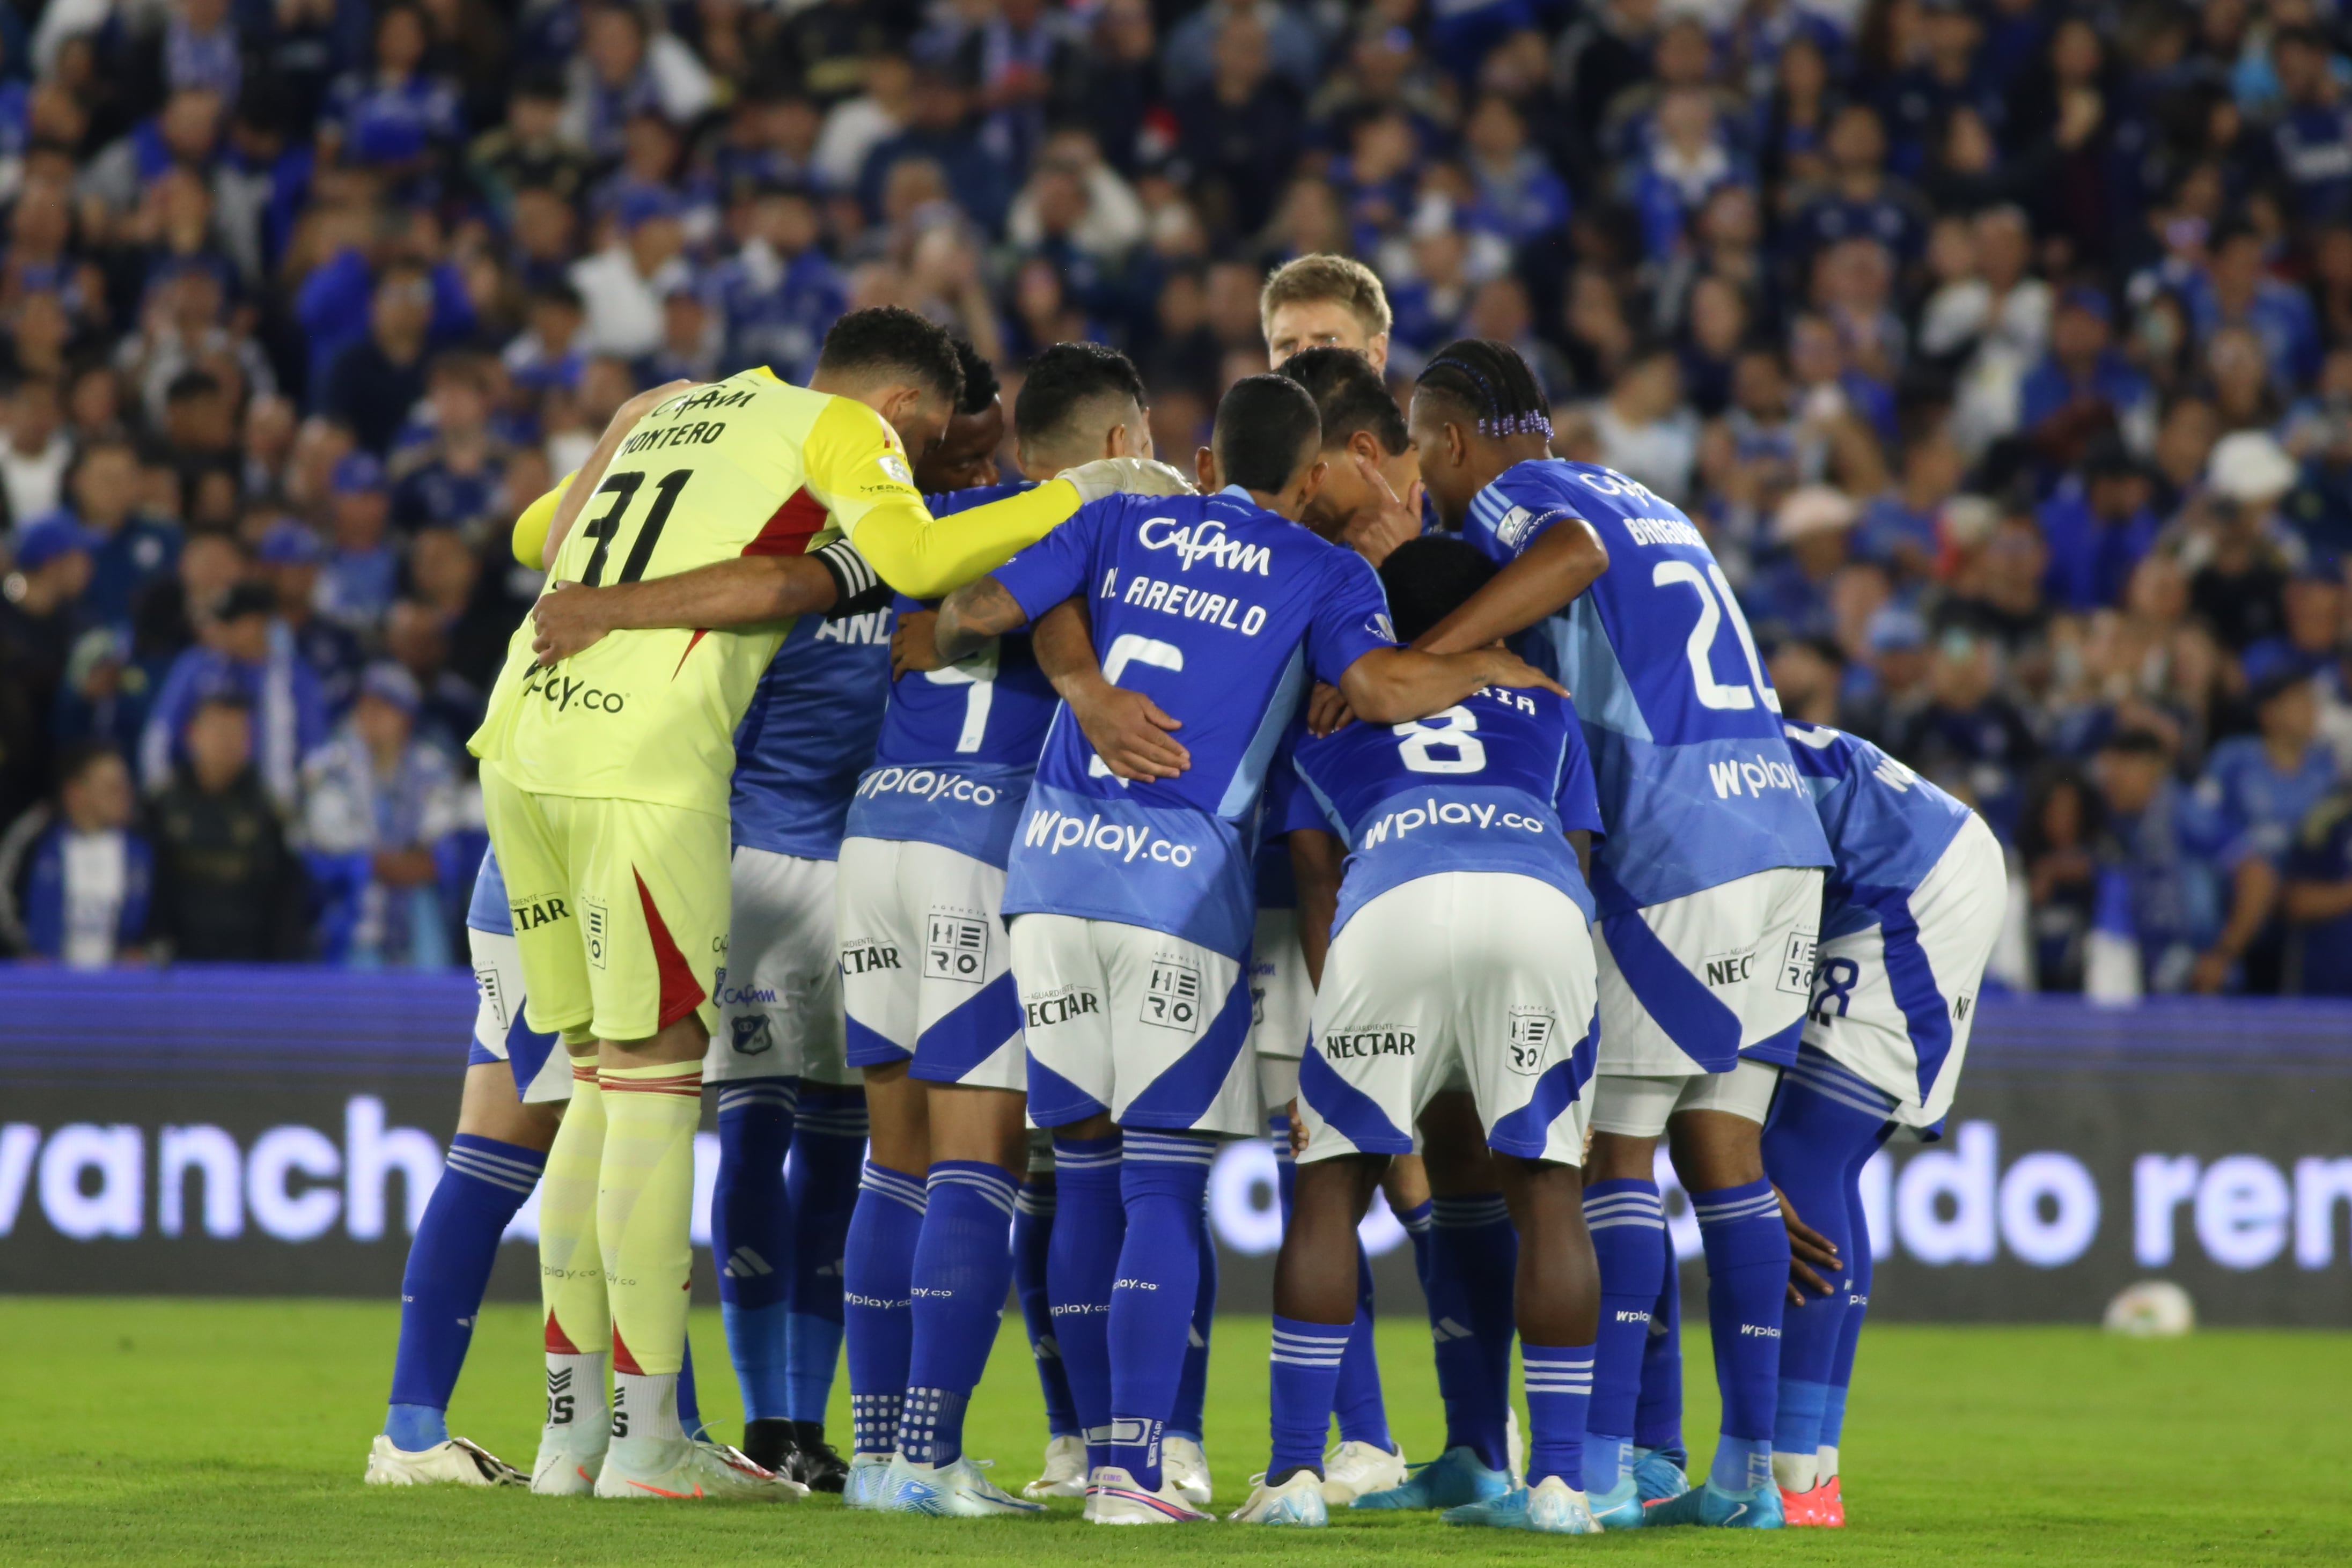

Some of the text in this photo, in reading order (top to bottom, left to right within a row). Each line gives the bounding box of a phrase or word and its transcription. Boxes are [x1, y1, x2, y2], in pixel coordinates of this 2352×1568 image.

[581, 469, 695, 588] 31
[1101, 566, 1267, 636] N. AREVALO
[1392, 704, 1487, 774] 8
[1024, 809, 1193, 868] Wplay.co
[1365, 798, 1544, 850] Wplay.co
[511, 898, 570, 931] TAR
[932, 904, 987, 917] AGENCIA
[1706, 951, 1756, 987] NEC
[1326, 1032, 1416, 1059] NECTAR
